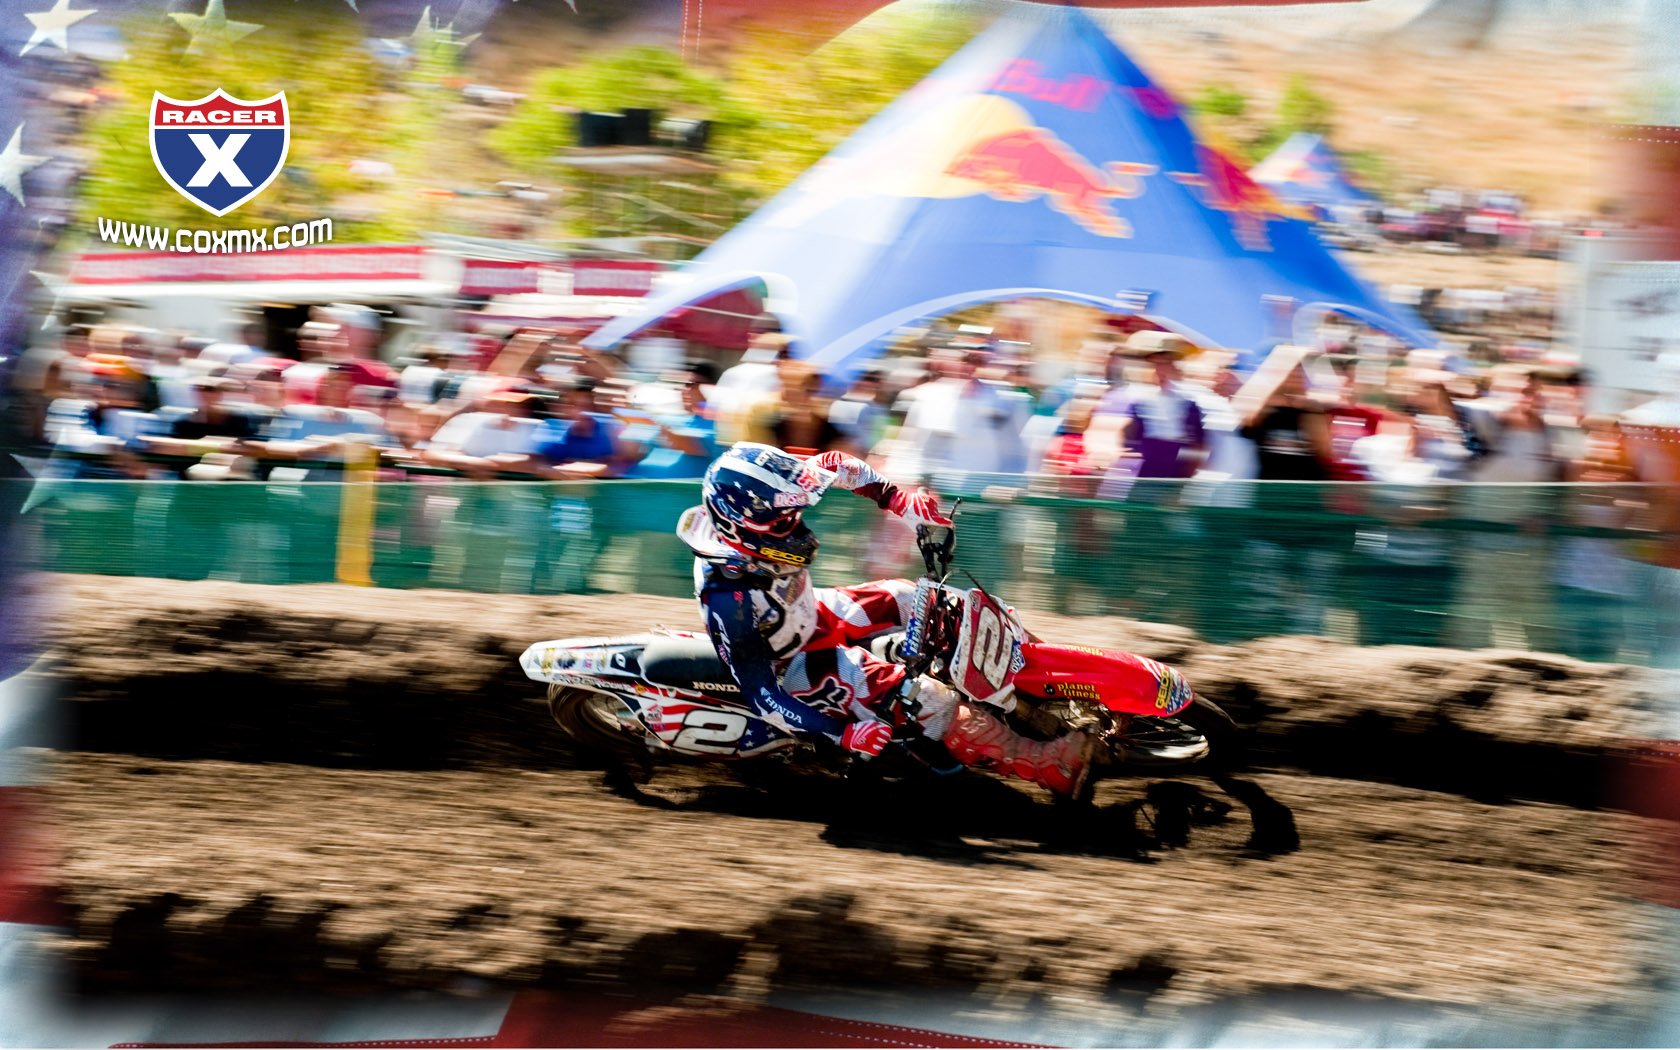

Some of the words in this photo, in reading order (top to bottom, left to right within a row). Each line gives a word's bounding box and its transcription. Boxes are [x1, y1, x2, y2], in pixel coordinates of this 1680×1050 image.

[972, 605, 1014, 692] 2
[692, 681, 741, 693] HOND
[1056, 682, 1095, 691] planet
[1063, 688, 1100, 700] fitness
[1155, 670, 1169, 709] GEICO
[765, 695, 803, 724] HONDA
[672, 709, 749, 756] 2
